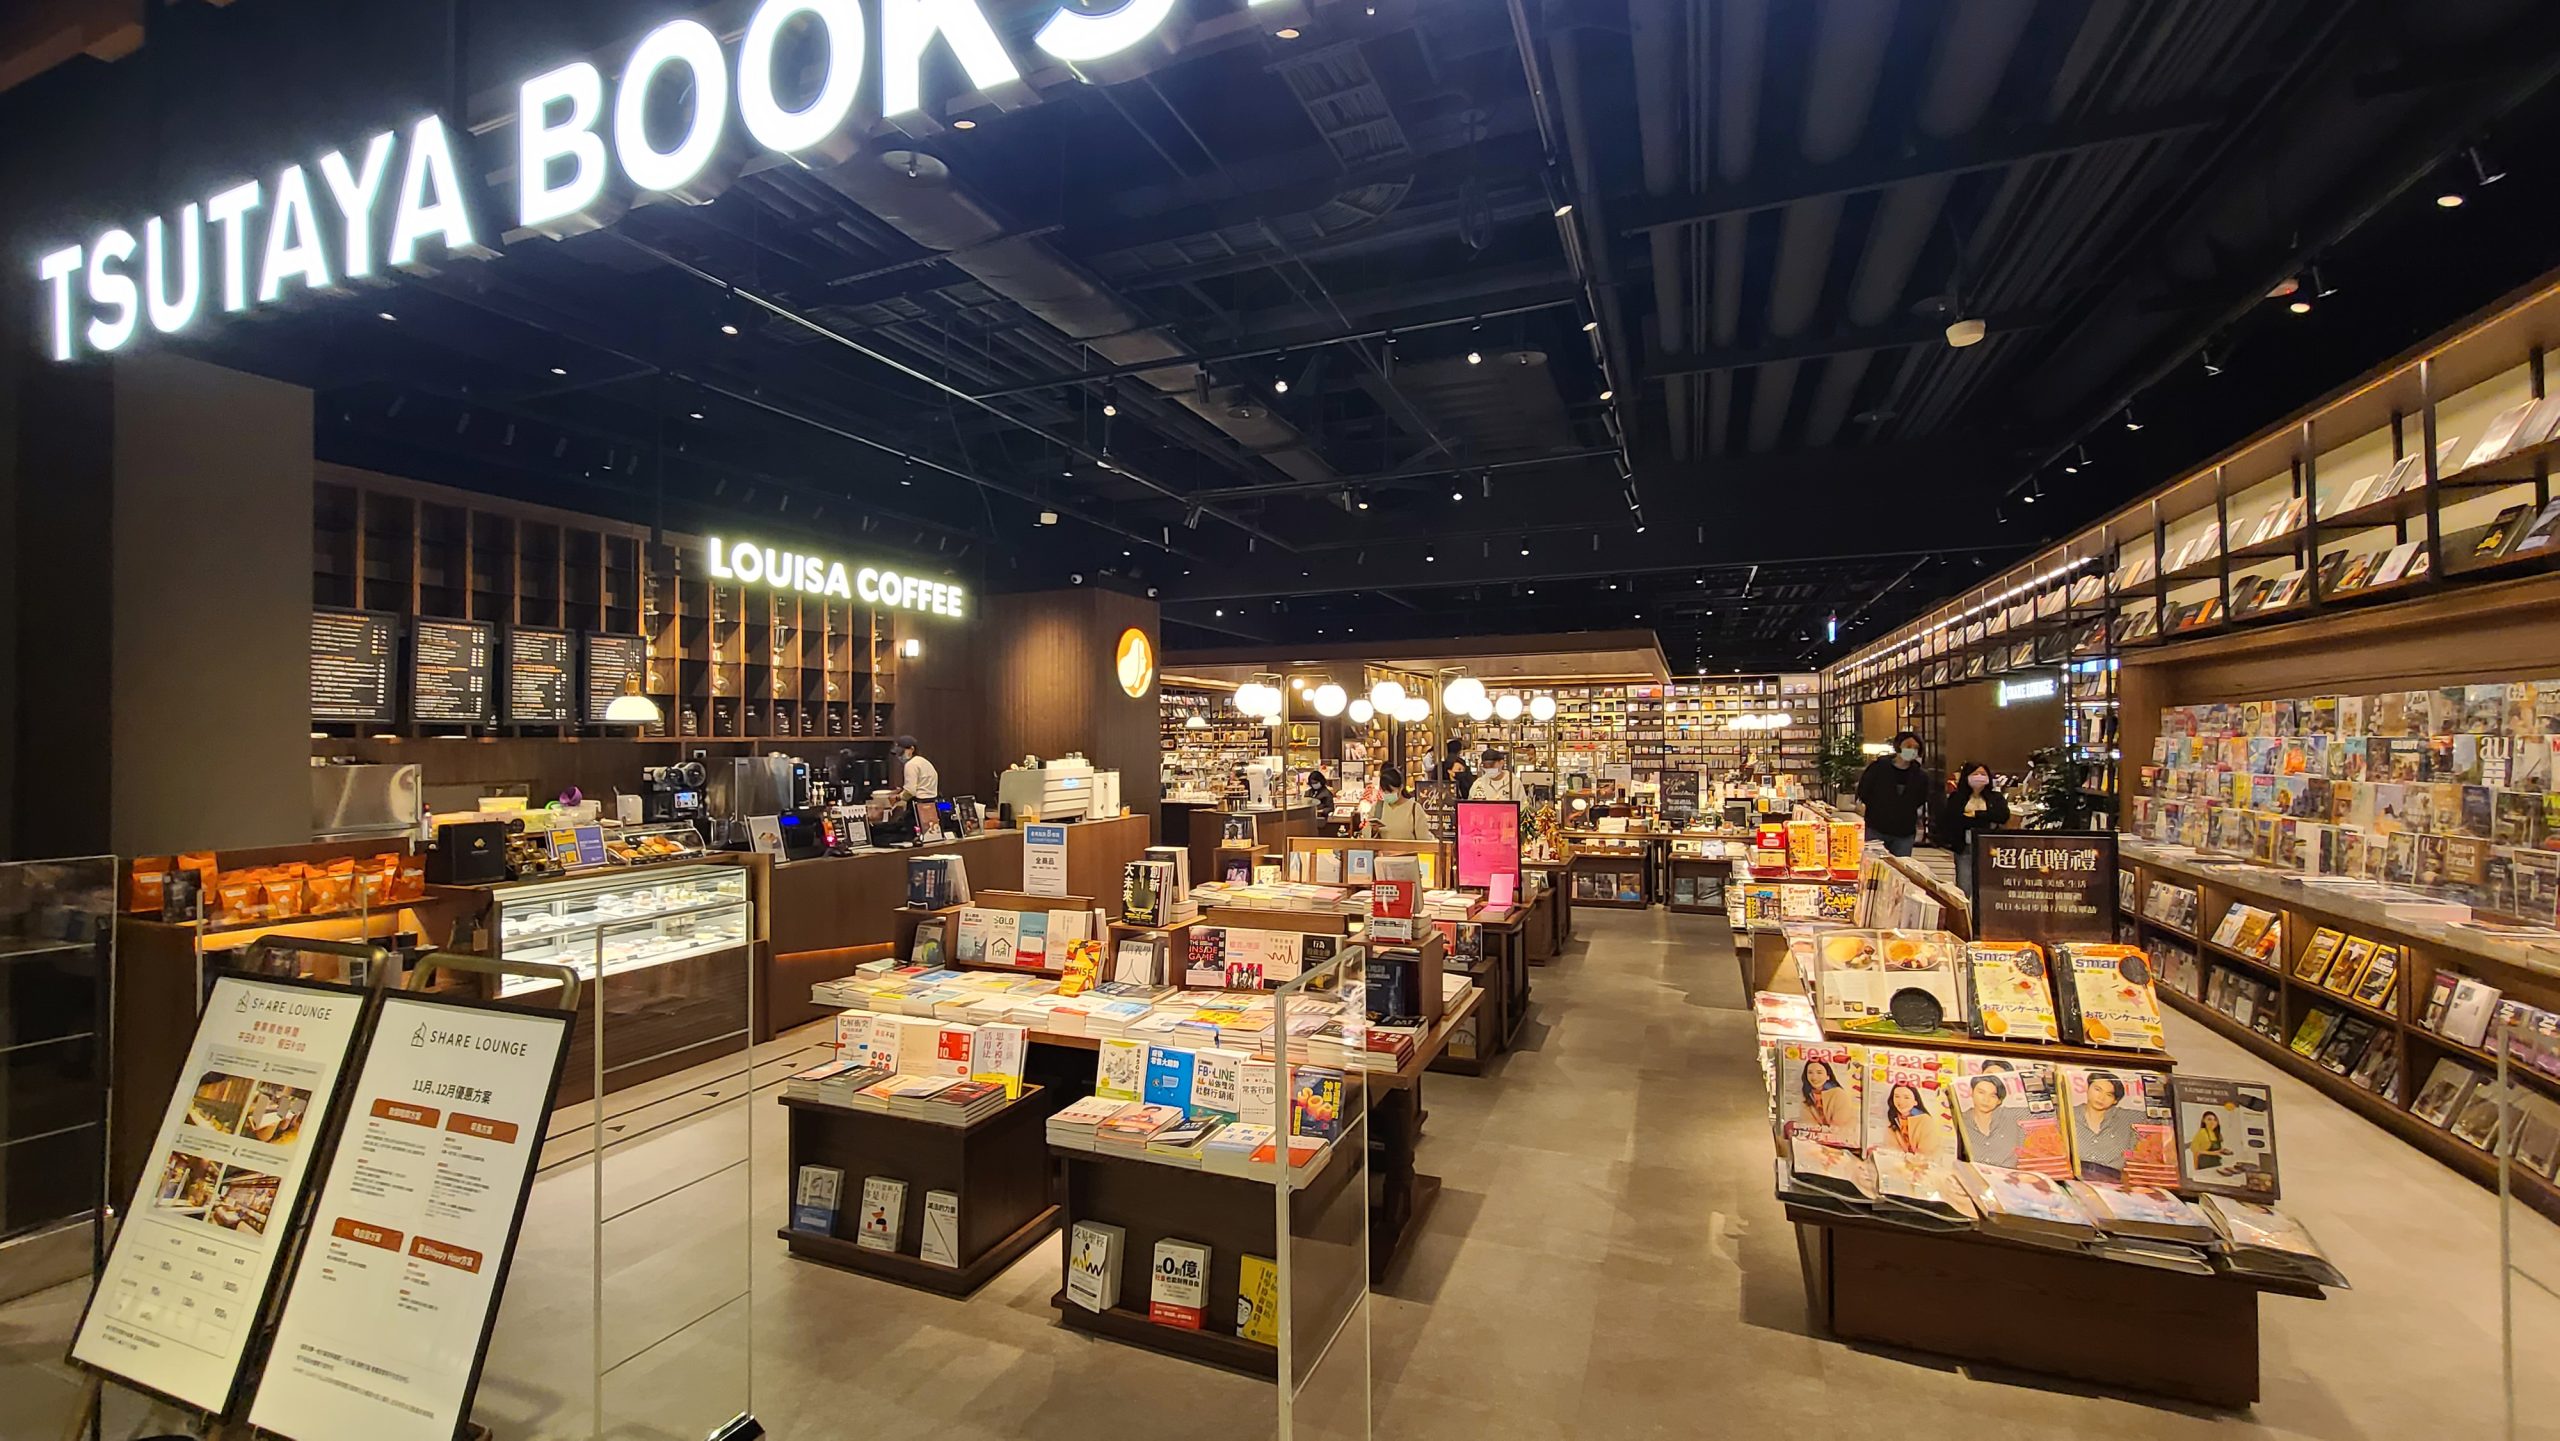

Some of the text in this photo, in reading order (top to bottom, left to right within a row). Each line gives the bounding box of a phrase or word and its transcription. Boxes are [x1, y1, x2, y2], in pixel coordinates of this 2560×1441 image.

[39, 0, 1192, 361] TSUTAYA BOOK
[709, 537, 963, 618] LOUISA COFFEE
[1991, 847, 2097, 871] 超值贈禮
[1122, 864, 1134, 902] 大未來
[1149, 865, 1160, 892] 創新
[1188, 953, 1215, 961] GAME
[1189, 945, 1218, 954] INSIDE
[1974, 952, 2017, 962] smar
[1065, 965, 1093, 976] SENSE
[2075, 958, 2119, 969] smar
[251, 997, 333, 1021] SHARE LOUNGE
[429, 1029, 528, 1058] SHARE LOUNGE
[1872, 1067, 1938, 1086] tead
[412, 1078, 493, 1105] 11月、12月優惠方案
